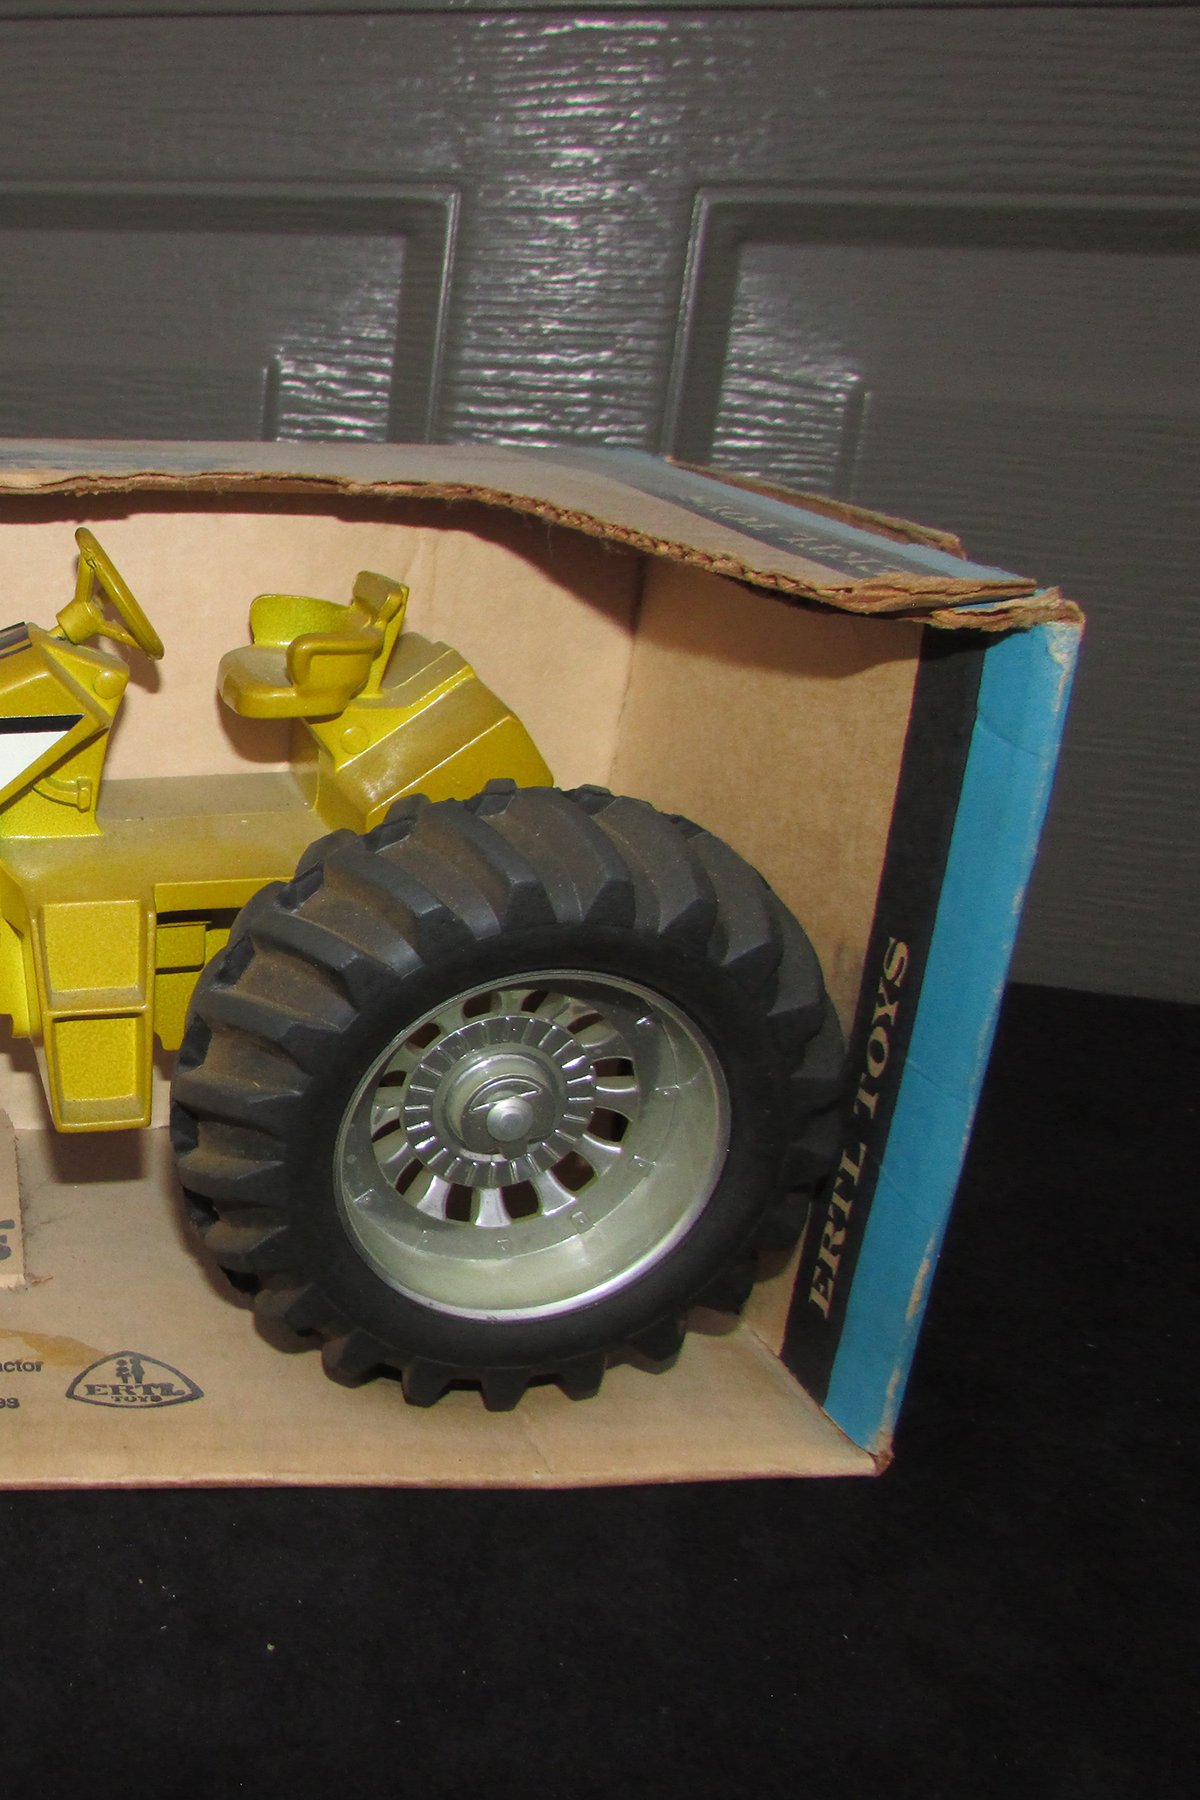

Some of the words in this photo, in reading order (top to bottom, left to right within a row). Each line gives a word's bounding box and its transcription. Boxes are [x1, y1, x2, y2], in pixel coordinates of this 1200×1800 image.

[808, 1142, 867, 1320] ERTL
[854, 937, 909, 1119] TOYS
[84, 1383, 186, 1396] ERTL
